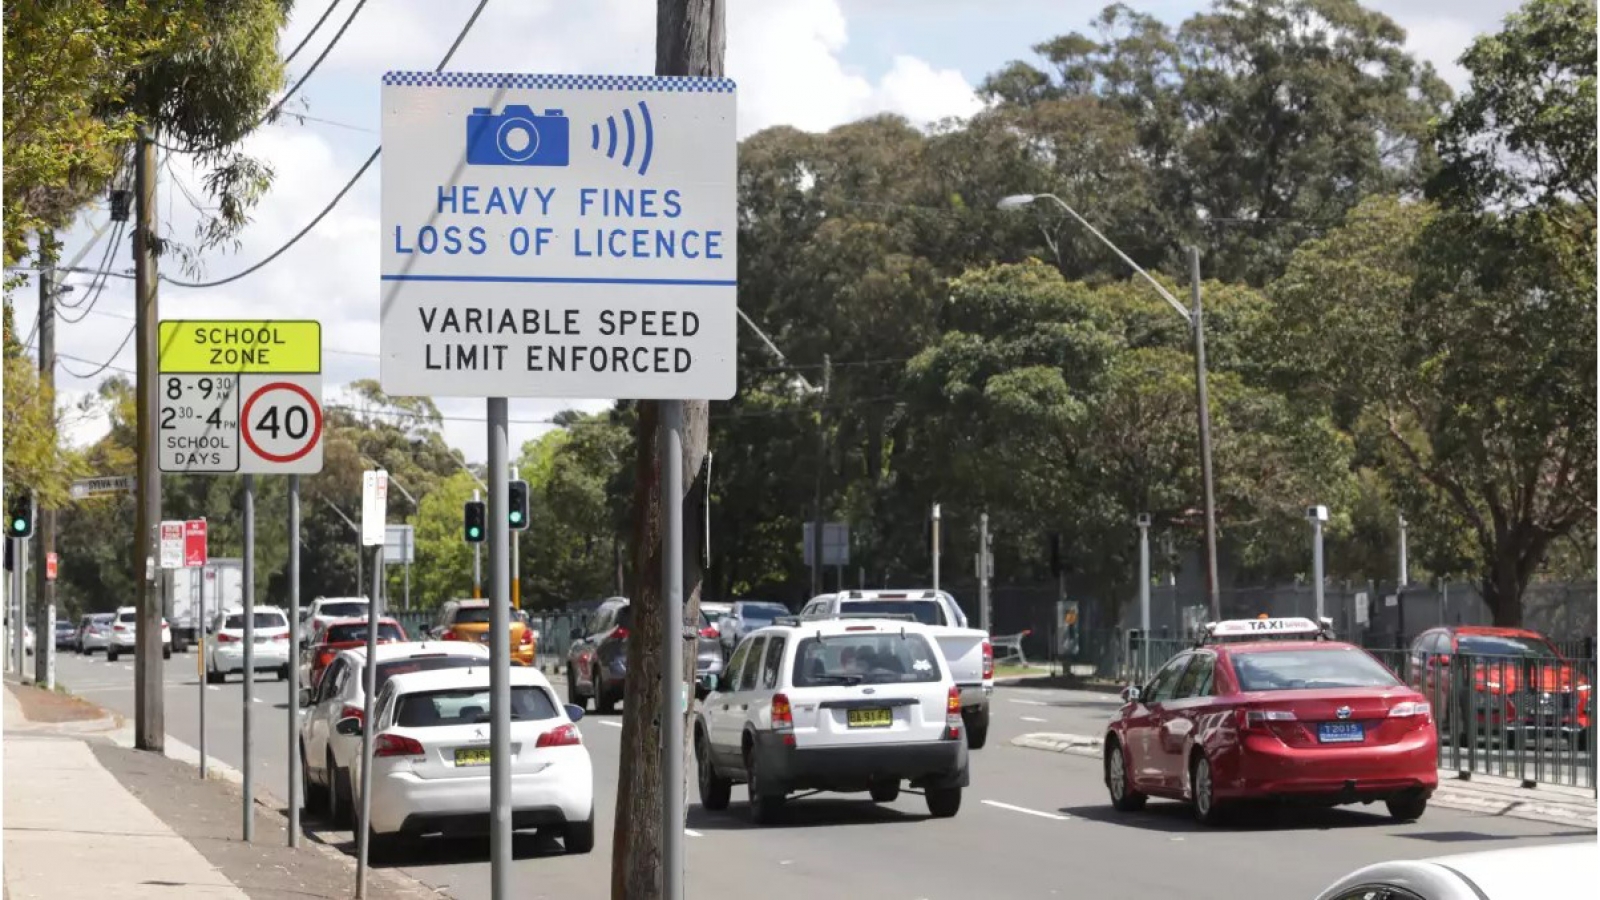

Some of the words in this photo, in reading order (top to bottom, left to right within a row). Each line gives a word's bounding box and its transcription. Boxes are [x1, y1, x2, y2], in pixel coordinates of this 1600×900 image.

[436, 185, 556, 215] HEAVY
[580, 188, 682, 219] FINES
[395, 225, 487, 255] LOSS
[509, 227, 553, 256] OF
[574, 228, 723, 259] LICENCE
[419, 307, 580, 335] VARIABLE
[598, 309, 700, 337] SPEED
[195, 327, 285, 344] SCHOOL
[209, 348, 269, 365] ZONE
[426, 344, 508, 371] LIMIT
[527, 345, 692, 373] ENFORCED
[256, 406, 308, 440] 40
[167, 436, 229, 449] SCHOOL
[175, 452, 220, 465] DAYS
[1248, 620, 1283, 630] TAXI
